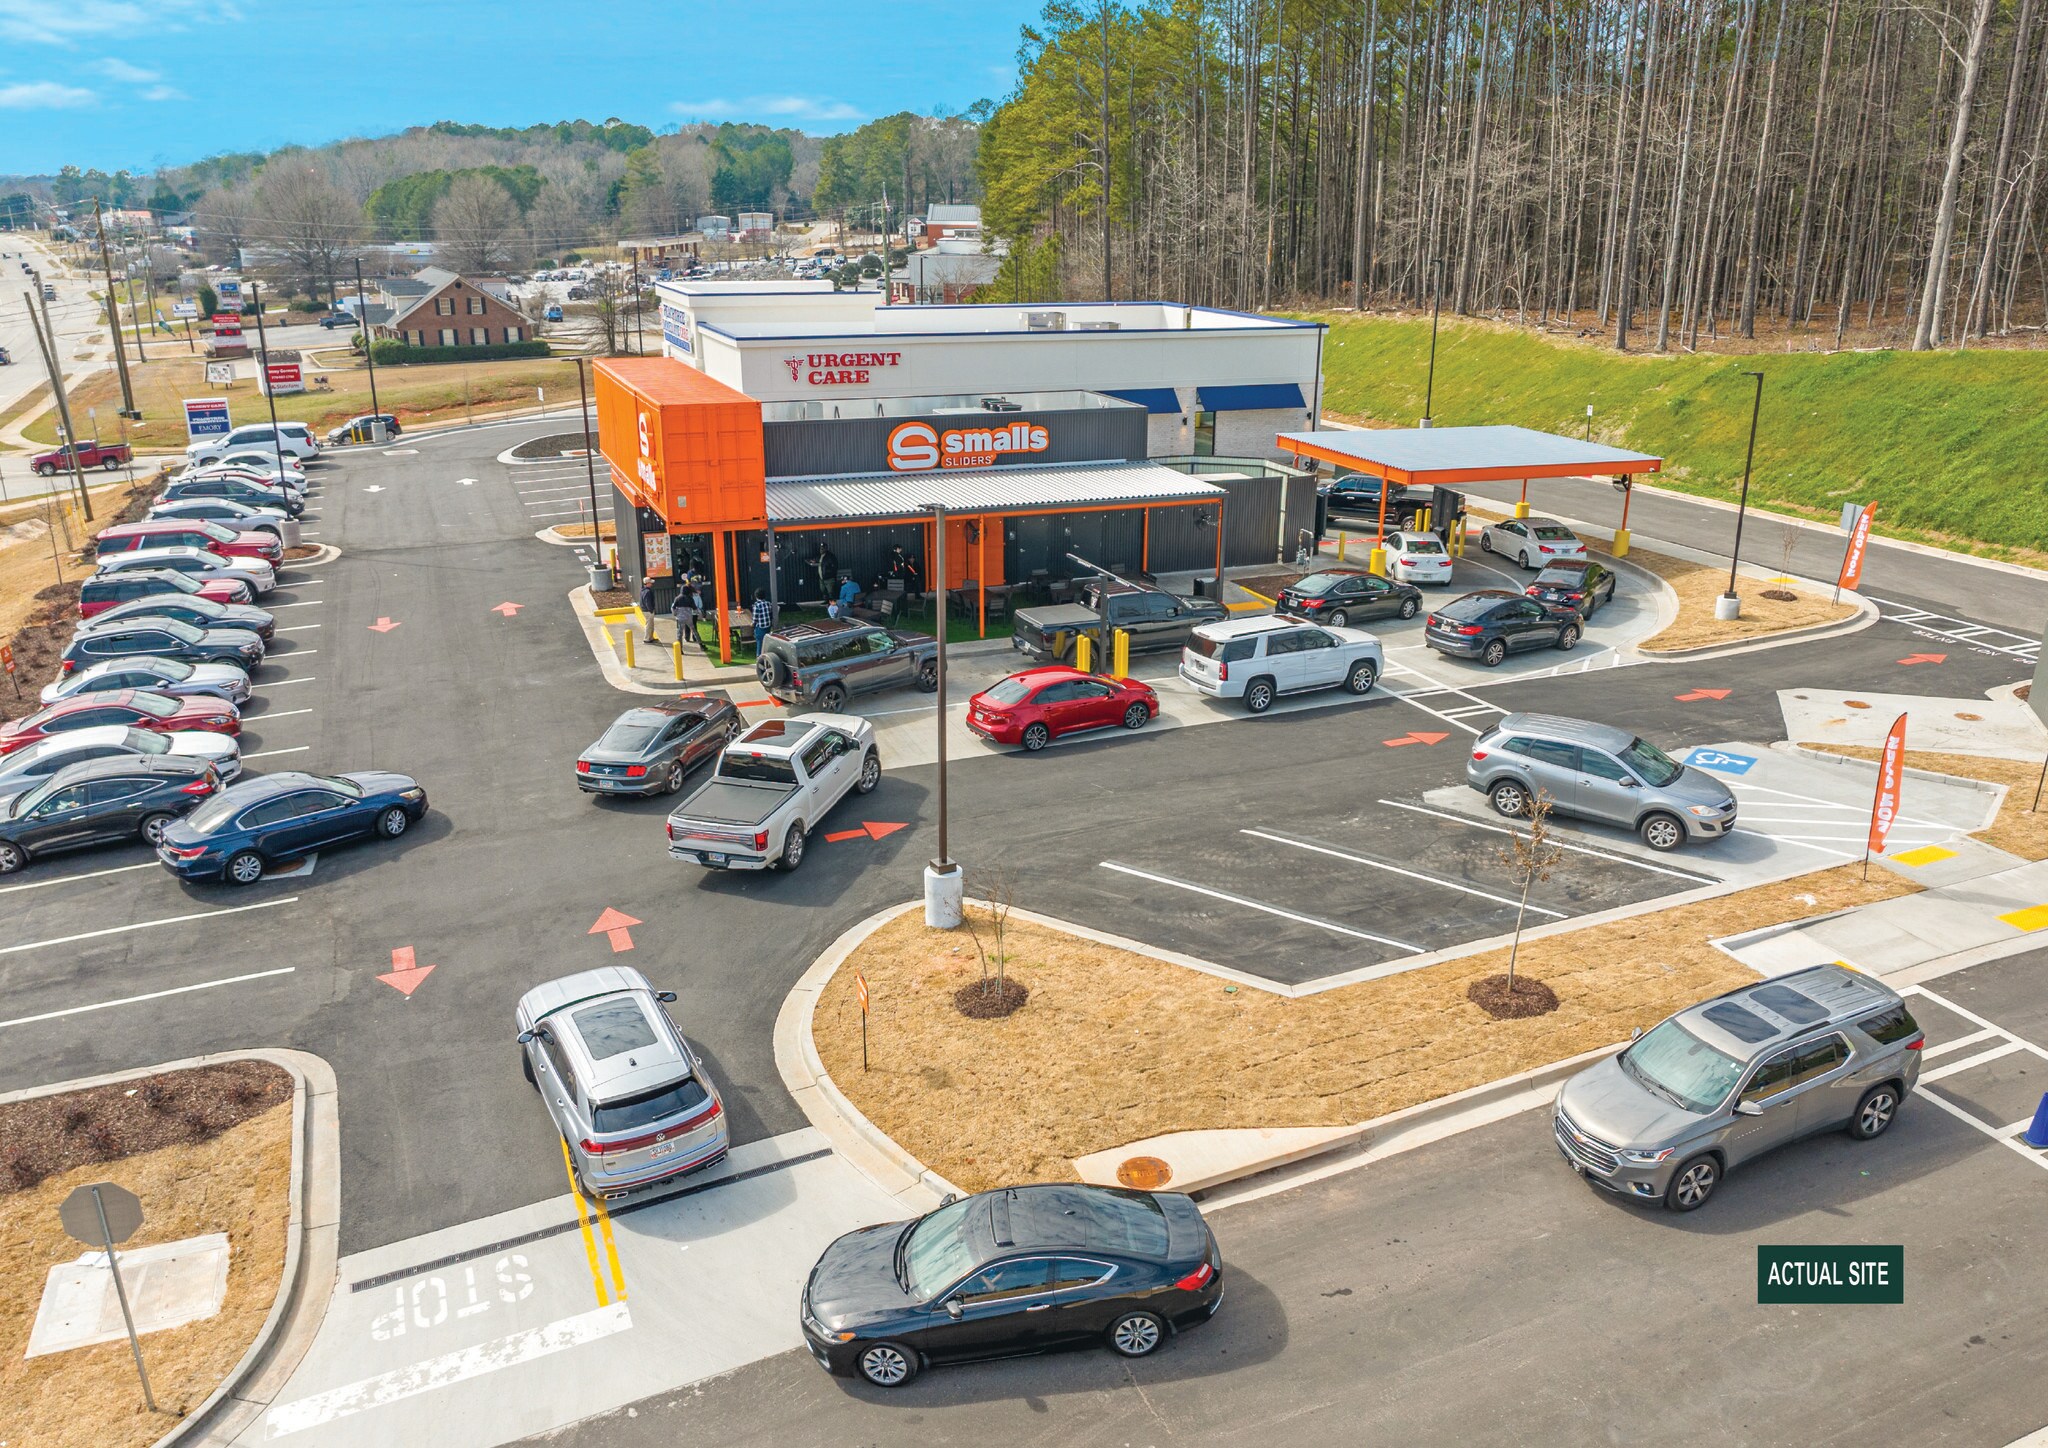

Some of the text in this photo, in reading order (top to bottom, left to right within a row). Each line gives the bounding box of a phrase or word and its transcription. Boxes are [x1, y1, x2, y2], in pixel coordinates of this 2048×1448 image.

[807, 352, 901, 368] URGENT
[808, 370, 870, 385] CARE
[945, 426, 1048, 453] smalls
[945, 456, 992, 466] SLIDERS
[1846, 513, 1870, 577] NOW OPEN
[1878, 735, 1900, 833] NOW OPEN
[371, 1254, 534, 1342] STOP
